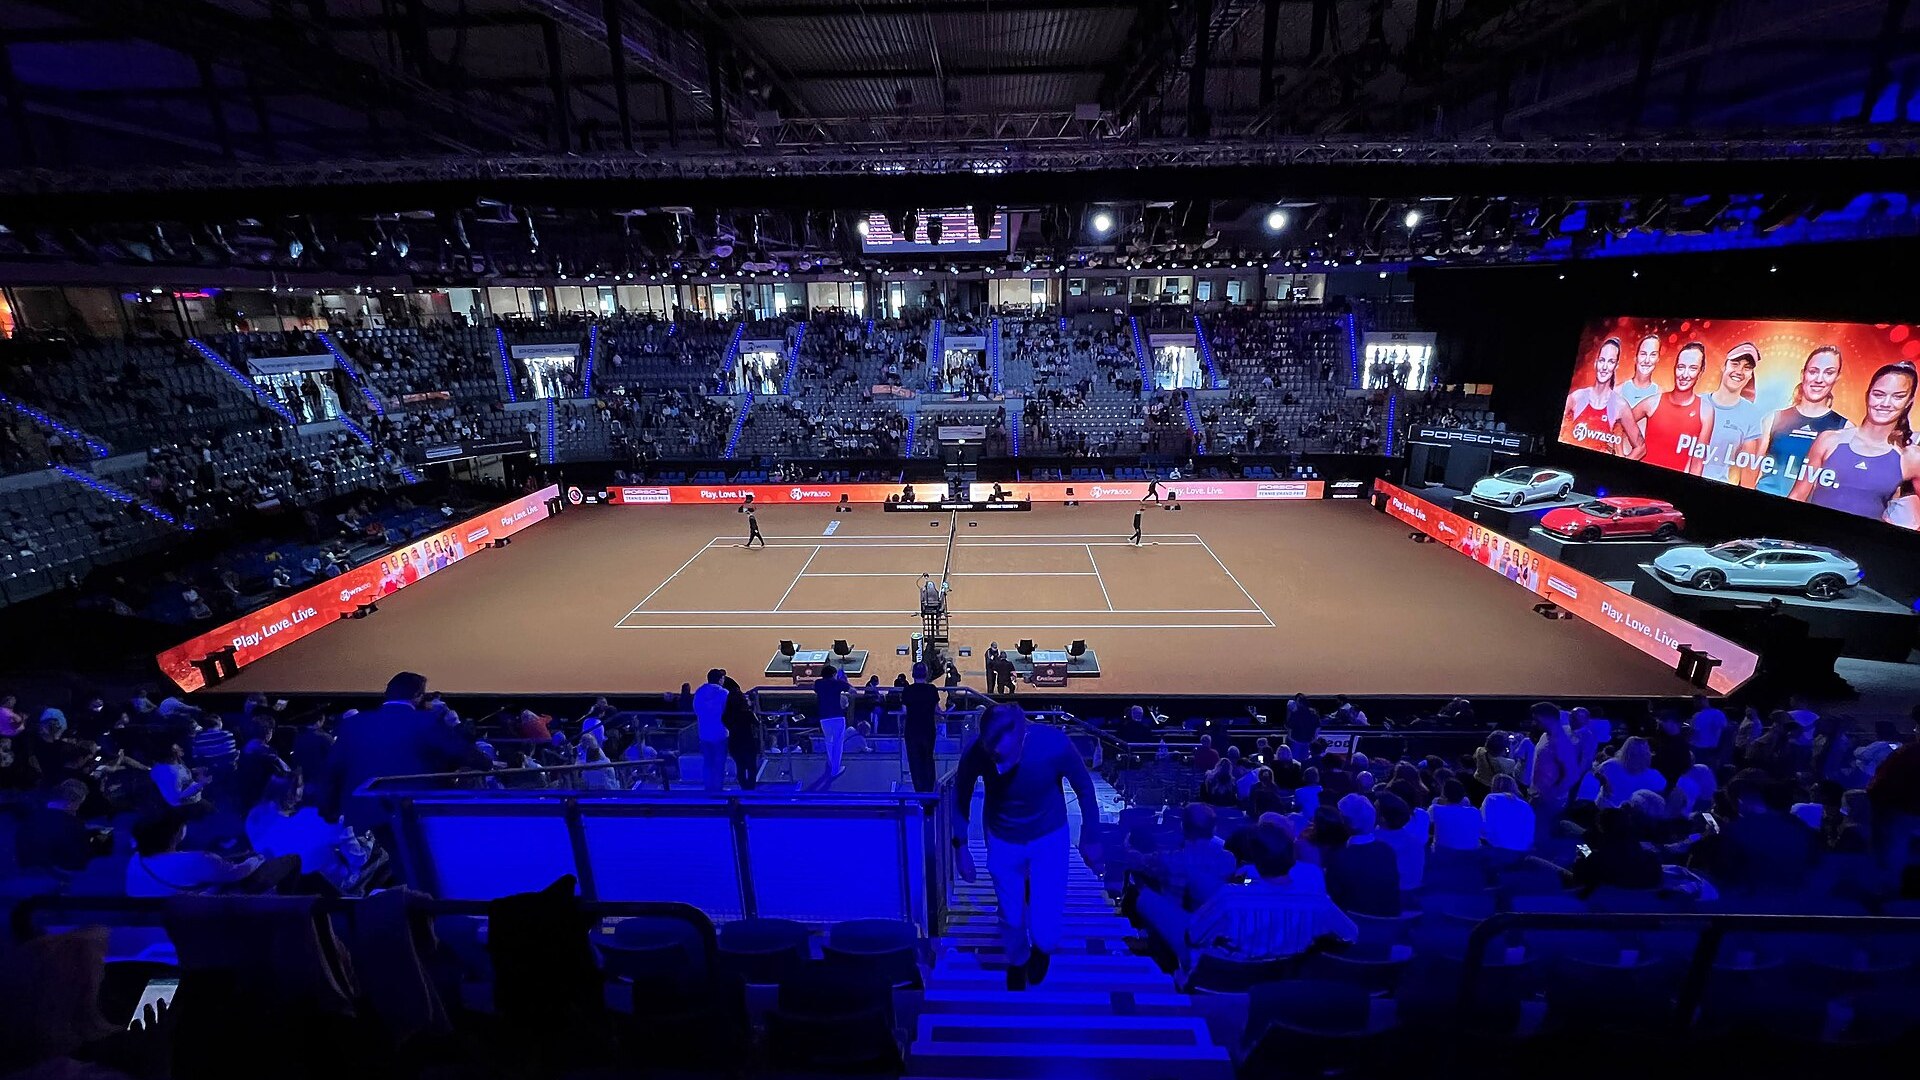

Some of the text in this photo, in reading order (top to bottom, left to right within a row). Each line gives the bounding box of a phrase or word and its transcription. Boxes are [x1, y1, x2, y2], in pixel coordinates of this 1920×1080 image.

[1420, 429, 1520, 447] PORSCHE
[1587, 430, 1622, 445] WTA500
[1676, 434, 1840, 489] Play. Love. Live.
[700, 490, 718, 499] Play.
[718, 490, 738, 498] Love.
[1186, 487, 1206, 495] Love.
[1207, 487, 1224, 495] Live.
[232, 606, 318, 651] Play. Love. Live.
[1601, 601, 1624, 623] Play.
[1625, 613, 1652, 638] Love.
